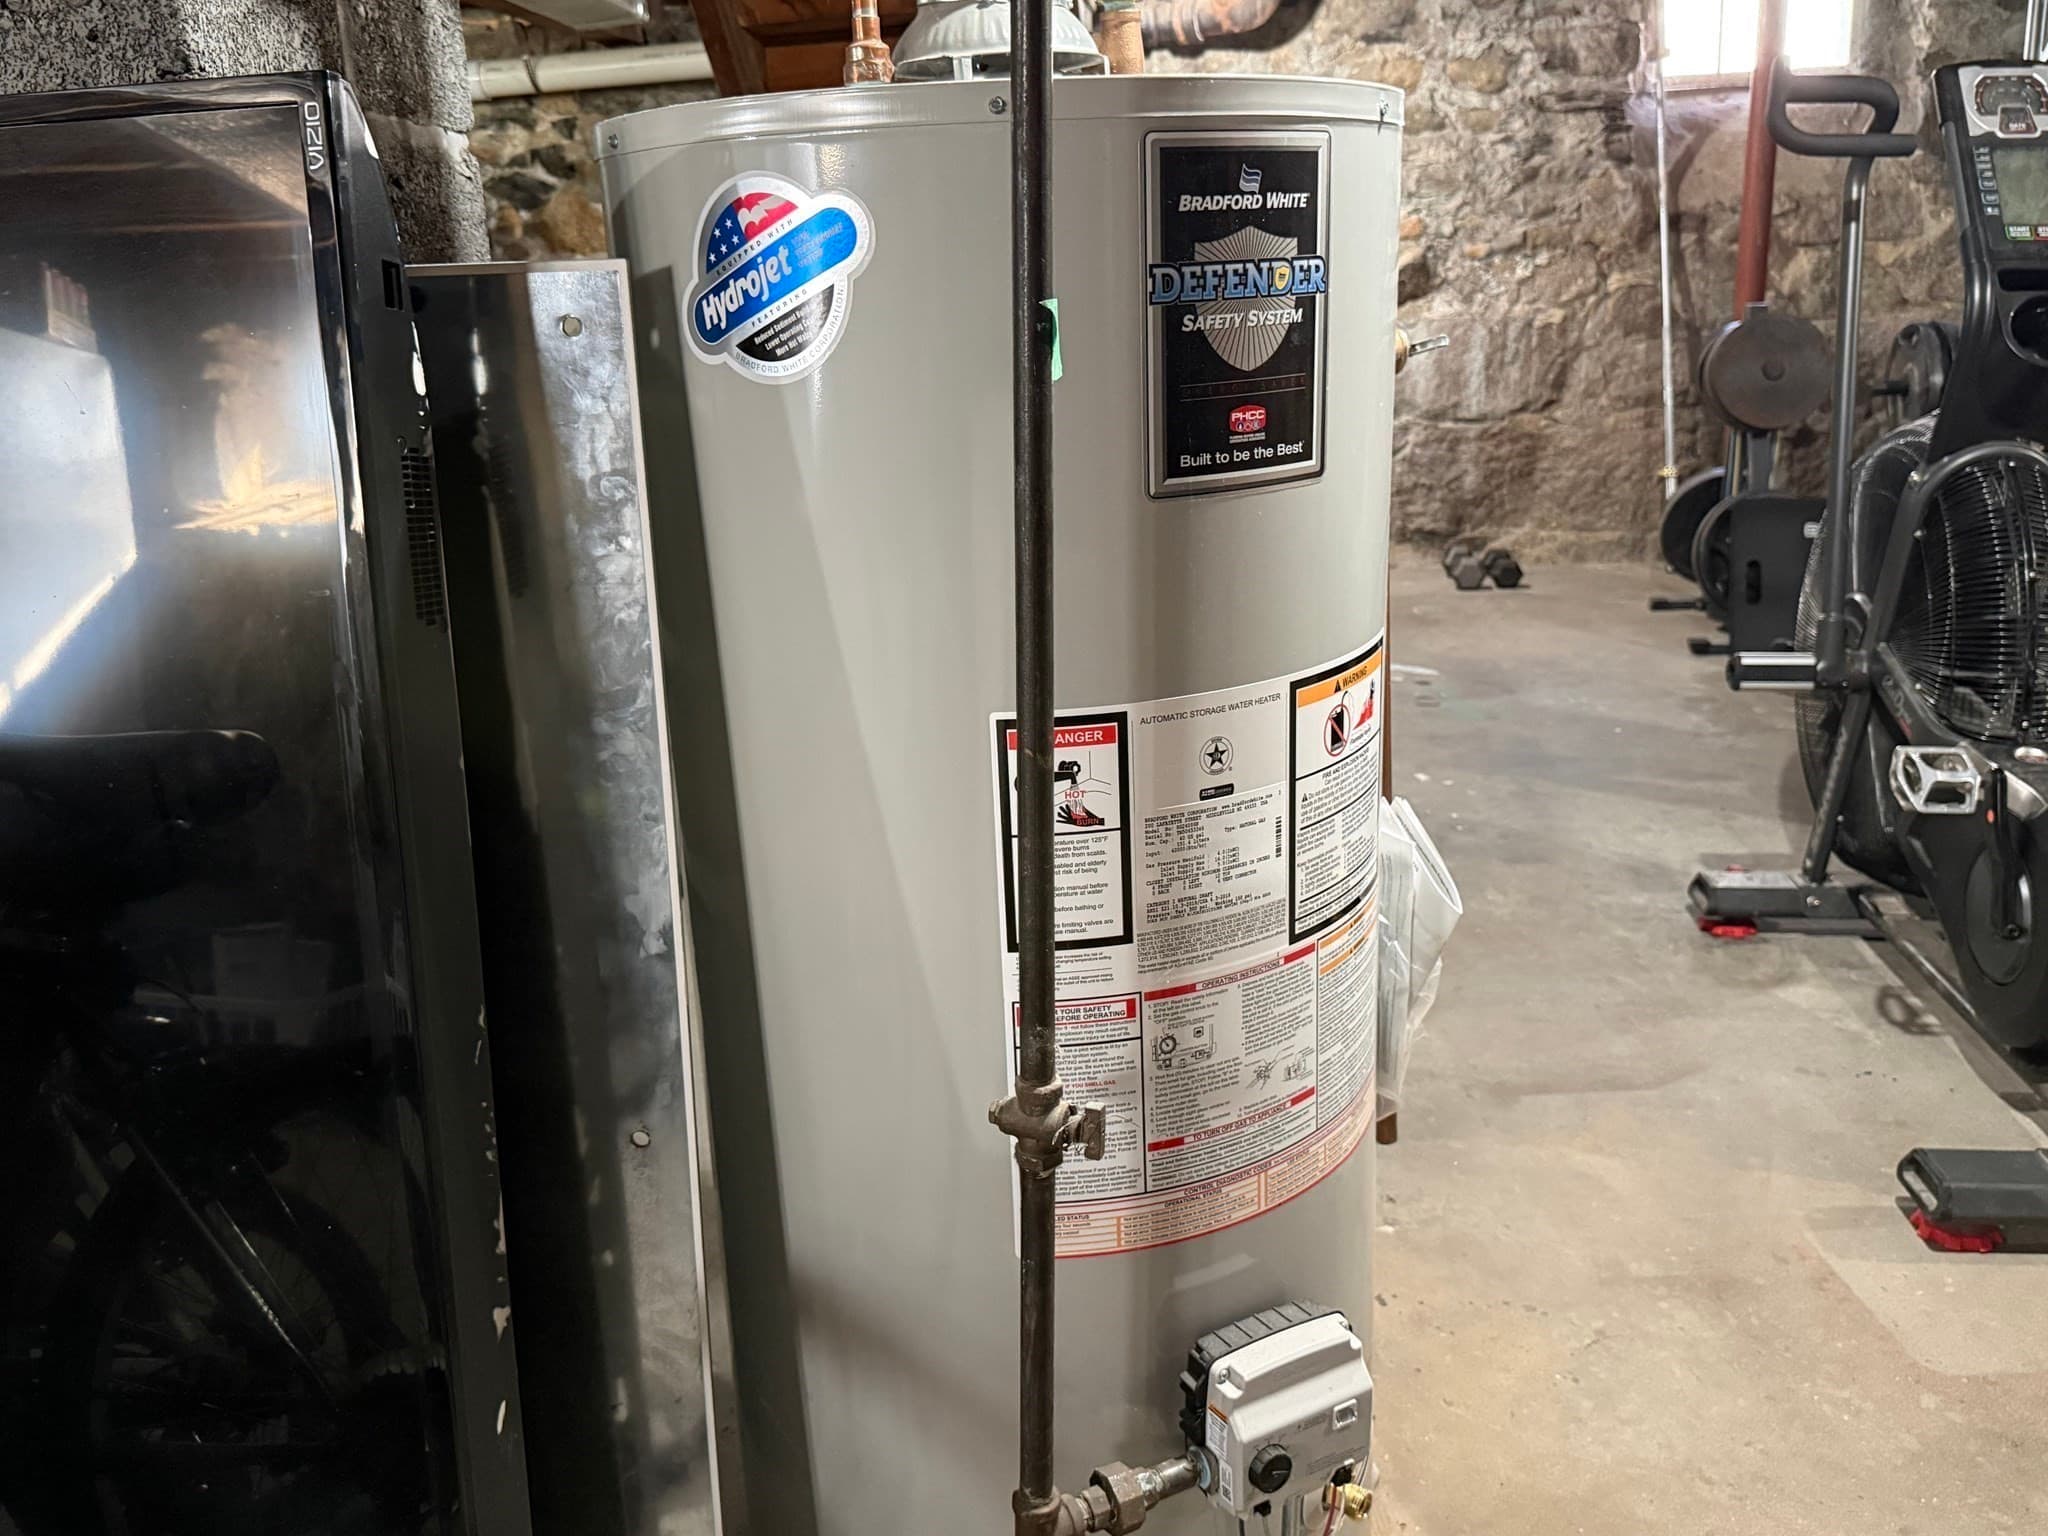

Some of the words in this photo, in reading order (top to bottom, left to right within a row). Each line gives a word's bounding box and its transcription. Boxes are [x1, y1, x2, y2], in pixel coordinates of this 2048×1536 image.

[304, 101, 324, 170] VIZIO
[1178, 193, 1262, 212] BRADFORD
[1266, 192, 1308, 209] WHITE
[716, 240, 761, 276] EQUIPPED
[768, 219, 793, 239] WITH
[701, 244, 792, 331] Hydrojet
[1151, 256, 1327, 304] DEFENDER
[751, 289, 807, 328] FEATURING
[1181, 312, 1244, 332] SAFETY
[1247, 308, 1303, 327] SYSTEM
[1231, 409, 1265, 422] PHCC
[1180, 452, 1212, 467] Built
[1216, 451, 1230, 464] to
[1233, 449, 1250, 462] be
[1254, 446, 1274, 459] the
[1277, 442, 1303, 456] Best
[1342, 666, 1367, 688] WARNING
[1140, 711, 1188, 725] AUTOMATIC
[1190, 705, 1226, 718] STORAGE
[1228, 698, 1254, 710] WATER
[1254, 692, 1281, 706] HEATER
[1055, 730, 1104, 744] ANGER
[1064, 790, 1086, 799] HOT
[1201, 973, 1239, 988] OPERATING
[1239, 961, 1281, 979] INSTRUCTIONS
[1060, 1007, 1081, 1015] YOUR
[1083, 1004, 1112, 1013] SAFETY
[1083, 1009, 1126, 1020] OPERATING
[1192, 1132, 1203, 1141] TO
[1203, 1127, 1220, 1138] TURN
[1221, 1123, 1235, 1134] OFF
[1235, 1118, 1249, 1130] GAS
[1250, 1115, 1260, 1126] TO
[1164, 1195, 1202, 1208] OPERATIONAL
[1203, 1188, 1222, 1199] STATUS
[1184, 1182, 1214, 1196] CONTROL
